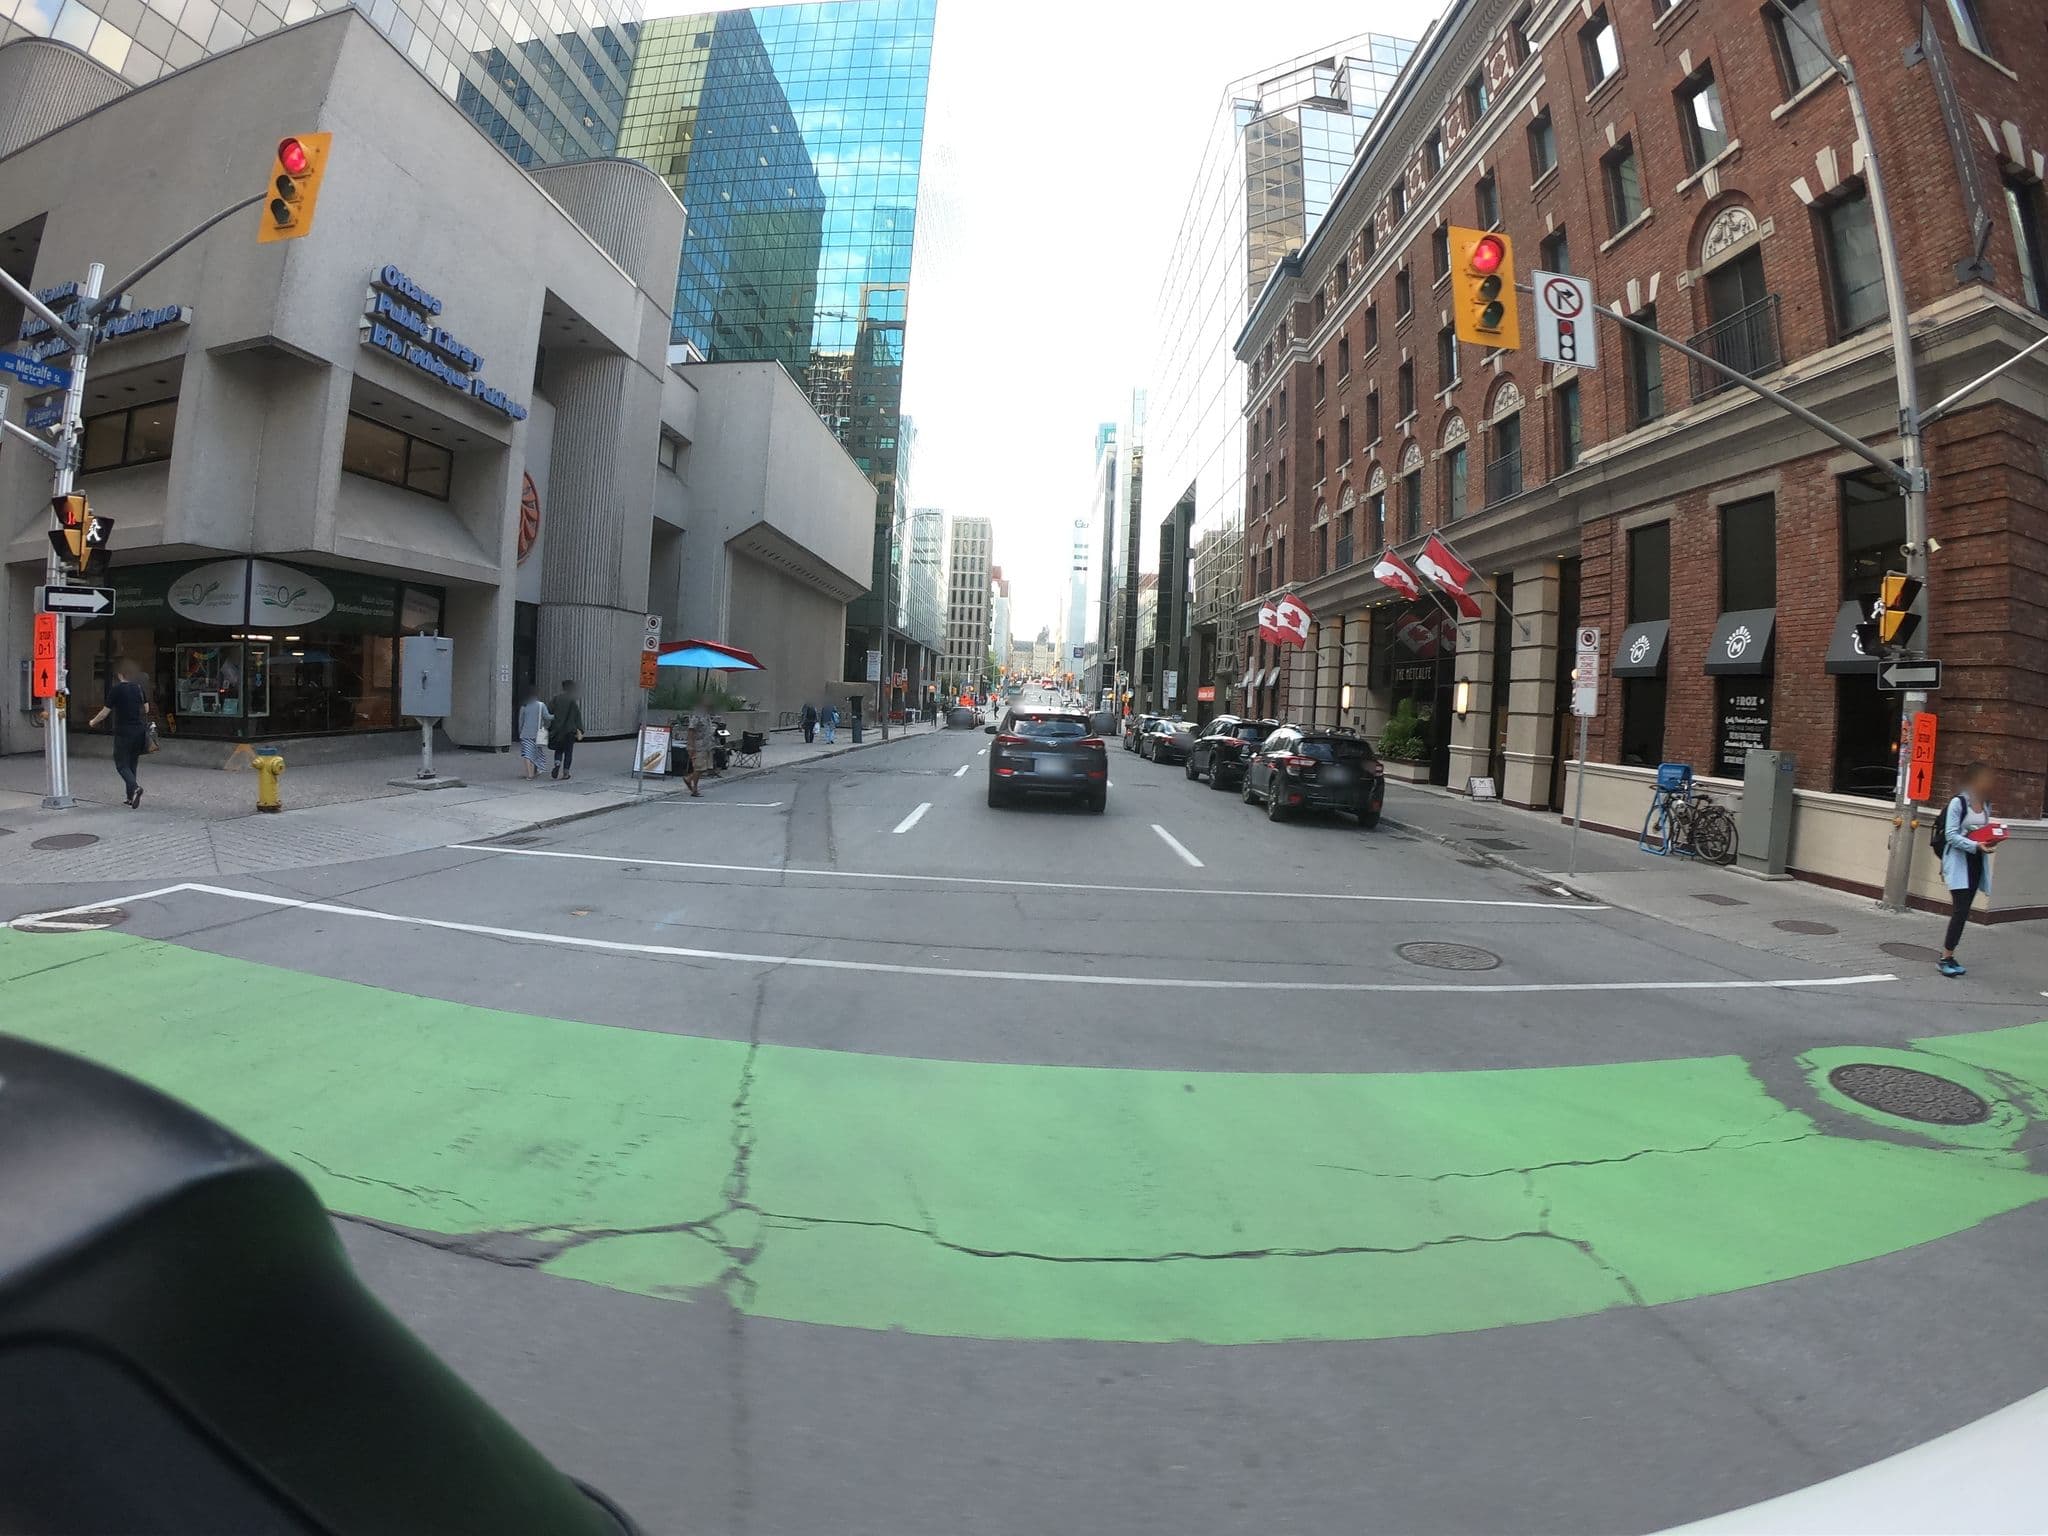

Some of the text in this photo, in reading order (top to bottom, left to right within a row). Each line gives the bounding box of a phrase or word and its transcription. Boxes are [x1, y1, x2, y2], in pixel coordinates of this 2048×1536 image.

[381, 264, 442, 315] Ottawa
[376, 293, 485, 373] Public Library
[16, 359, 53, 380] Metcalfe
[38, 643, 52, 656] D-1
[1917, 746, 1931, 760] D-1
